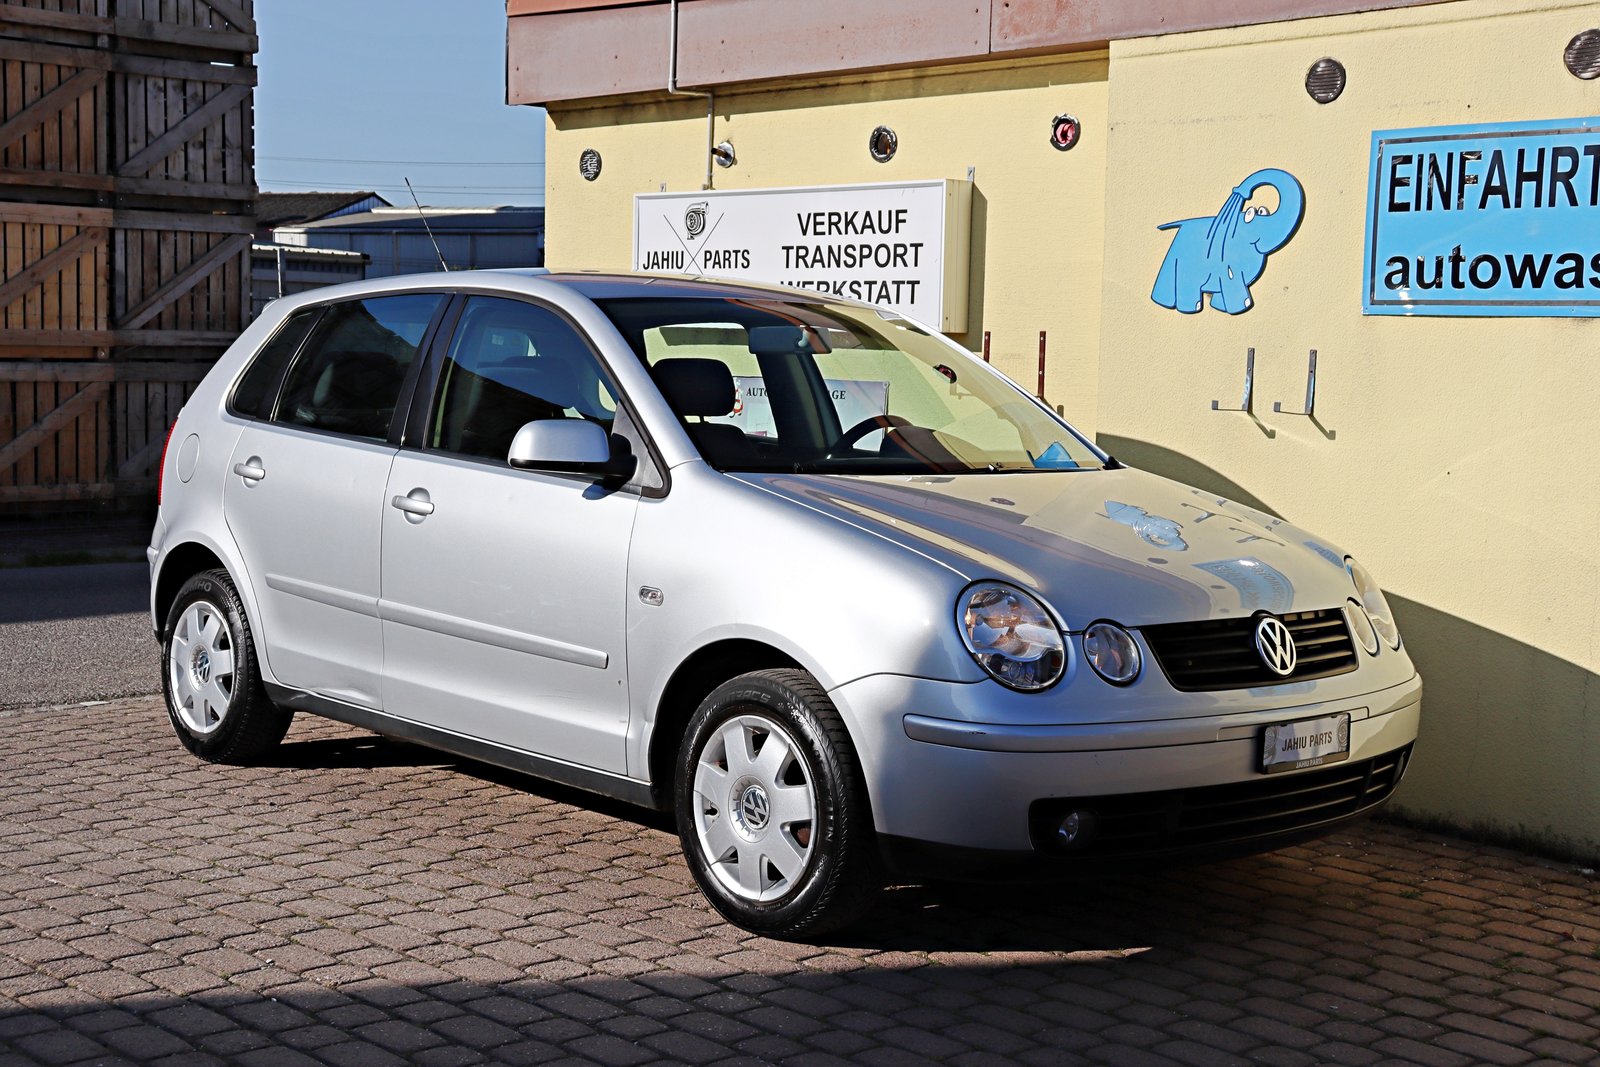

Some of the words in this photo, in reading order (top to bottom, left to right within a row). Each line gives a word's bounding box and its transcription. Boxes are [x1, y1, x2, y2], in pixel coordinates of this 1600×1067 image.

[1388, 144, 1600, 213] EINFAHRT
[797, 209, 908, 236] VERKAUF
[642, 250, 685, 270] JAHIU
[703, 249, 750, 269] PARTS
[781, 242, 924, 269] TRANSPORT
[1258, 617, 1297, 676] VW
[1281, 735, 1307, 752] JAHIU
[1309, 731, 1333, 747] PARTS
[741, 785, 770, 830] VW
